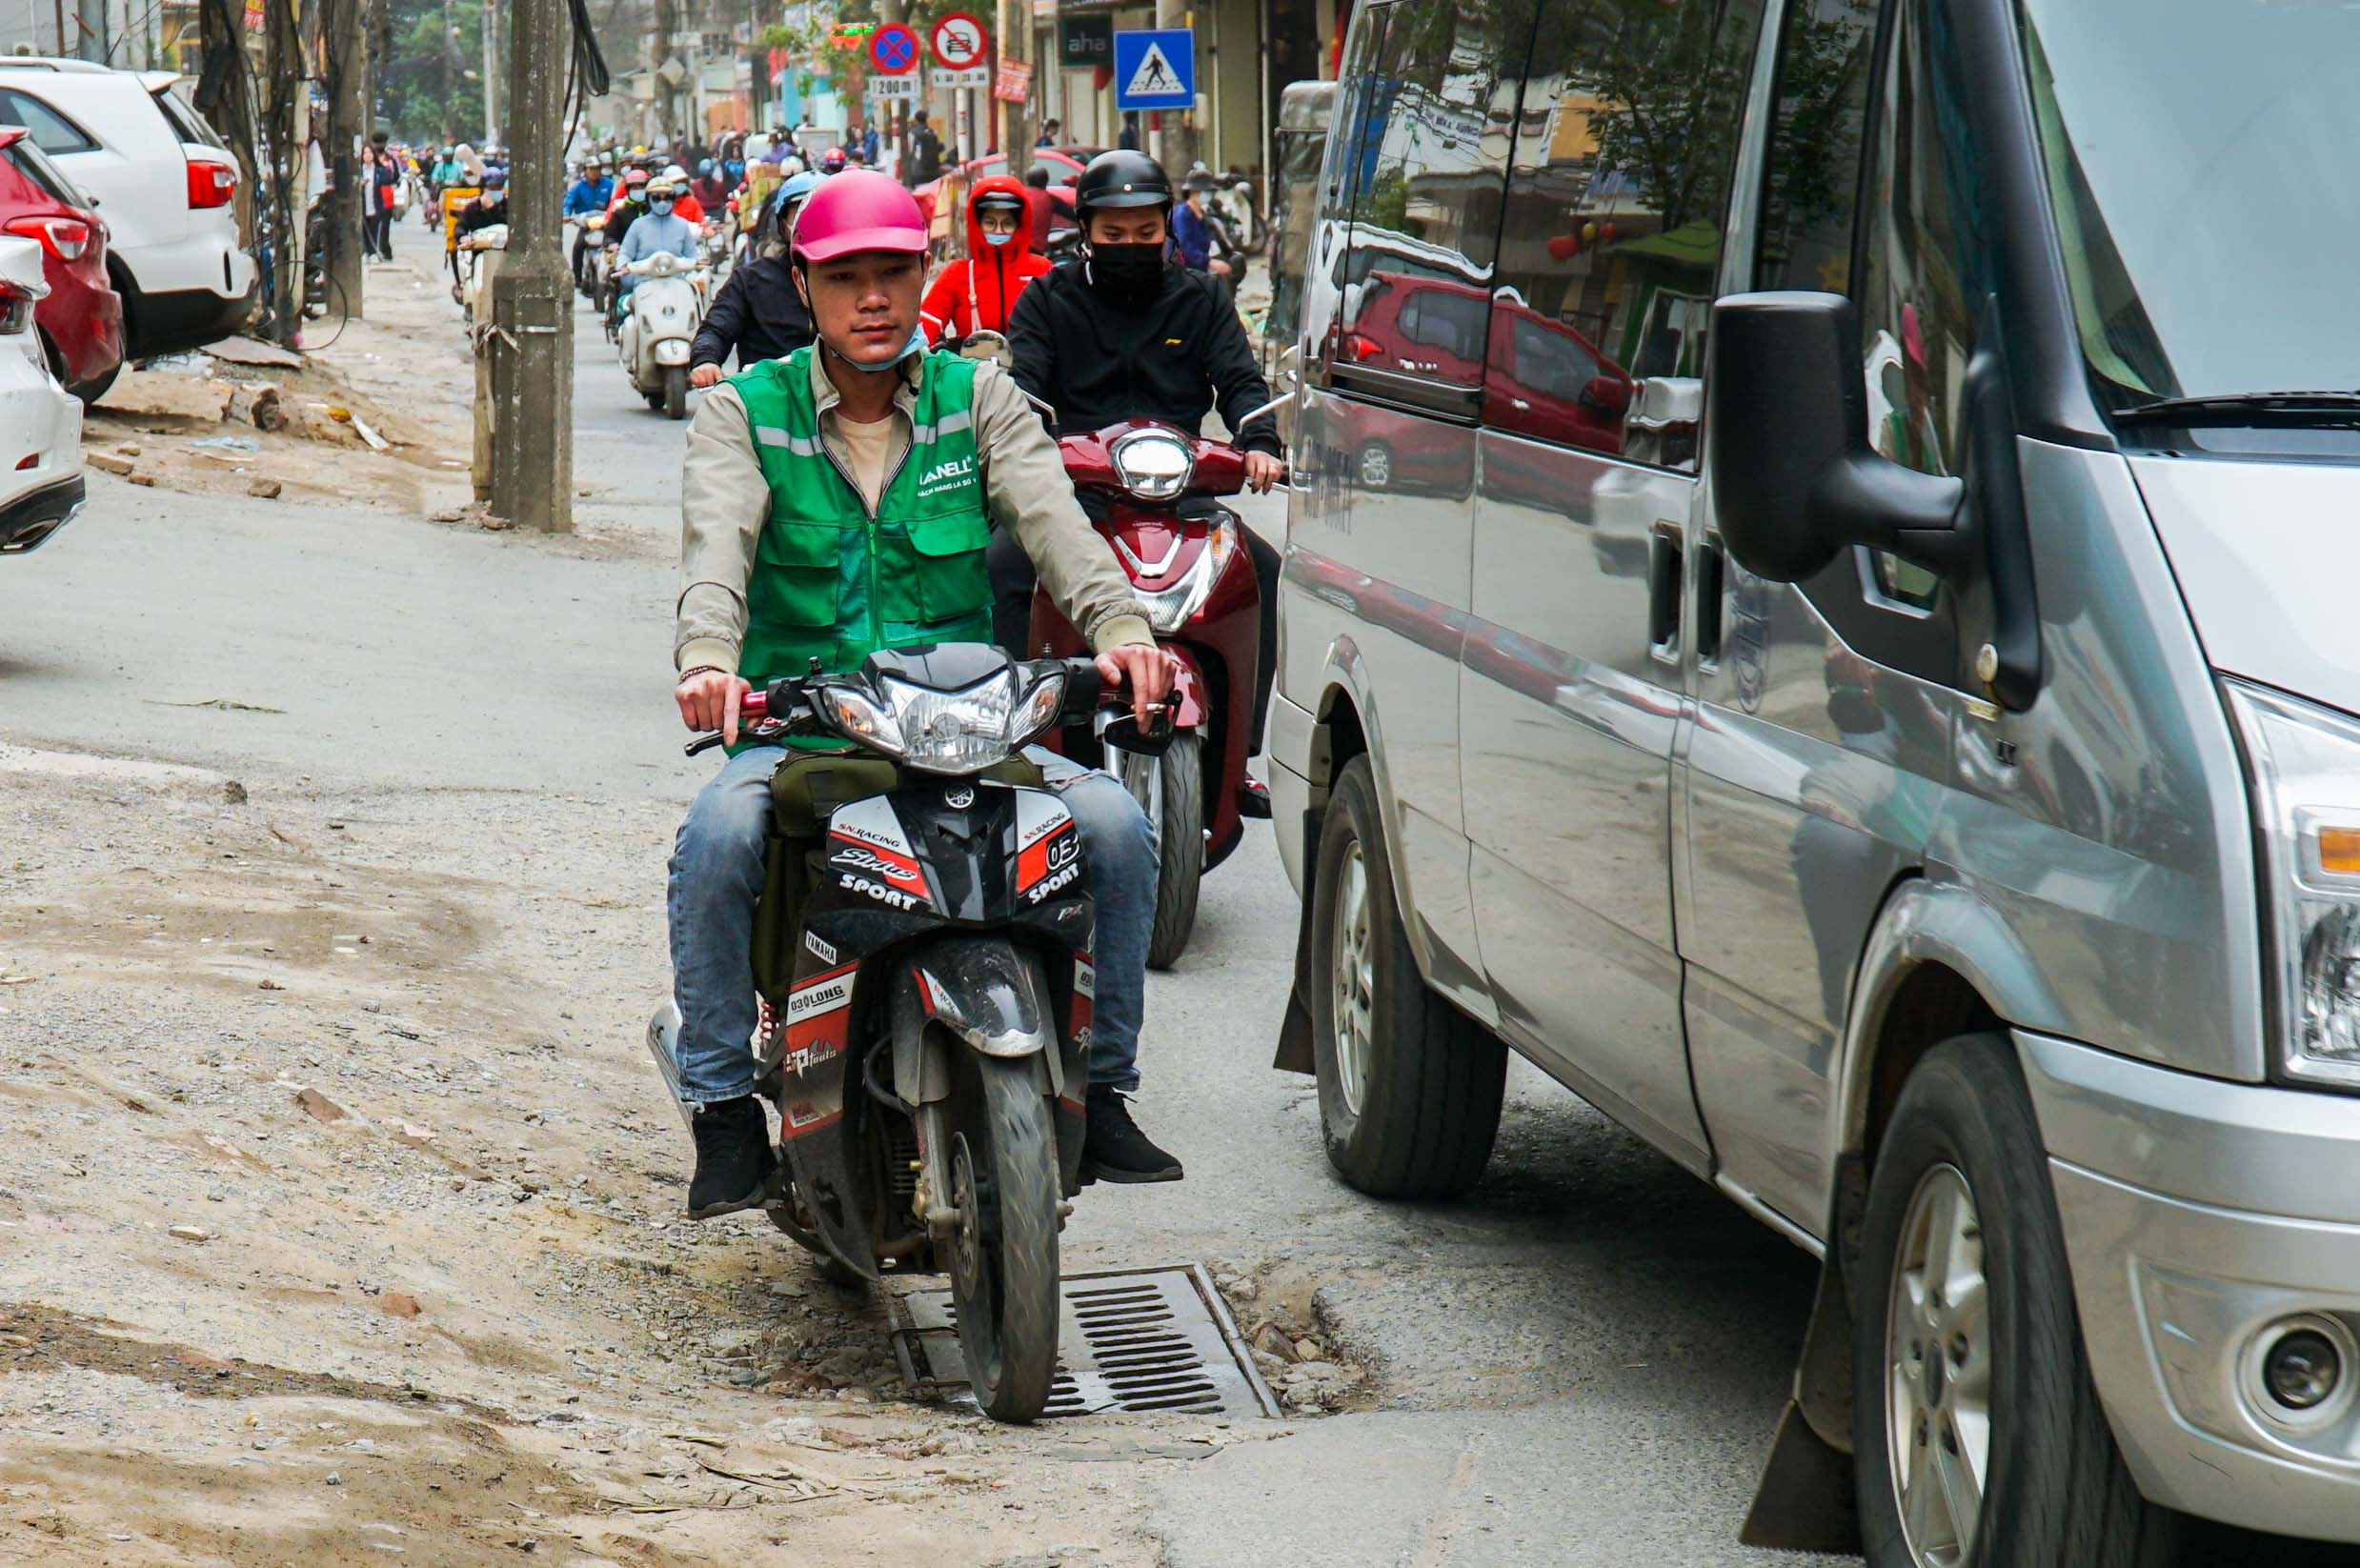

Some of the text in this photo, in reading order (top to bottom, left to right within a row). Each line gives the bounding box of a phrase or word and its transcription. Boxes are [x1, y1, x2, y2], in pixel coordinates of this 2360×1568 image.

[839, 874, 917, 912] SPORT
[1029, 862, 1079, 905] SPORT
[806, 933, 836, 963] YAMAHA
[811, 985, 844, 1005] LONG
